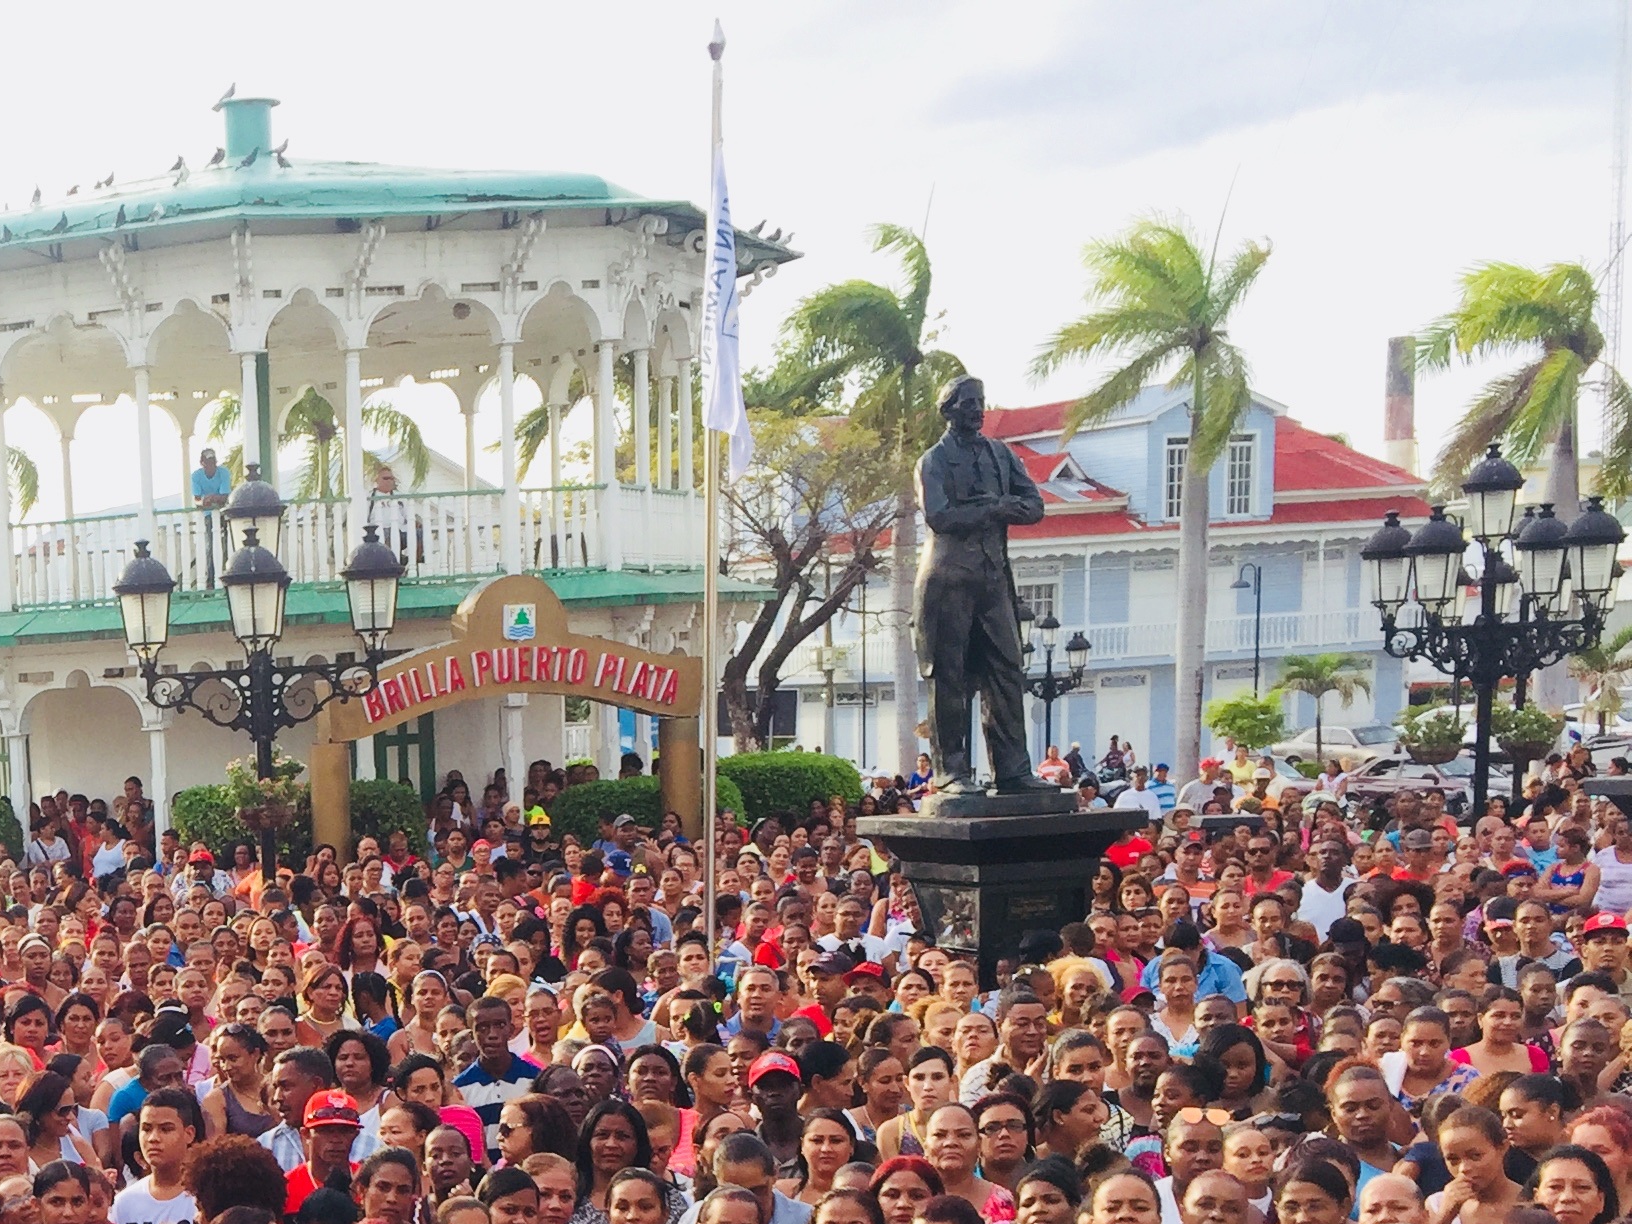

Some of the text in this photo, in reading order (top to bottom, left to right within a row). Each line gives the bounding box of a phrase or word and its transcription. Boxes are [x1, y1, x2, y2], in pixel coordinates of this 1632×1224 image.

[361, 646, 678, 724] BRILLA PUERTO PLATA
